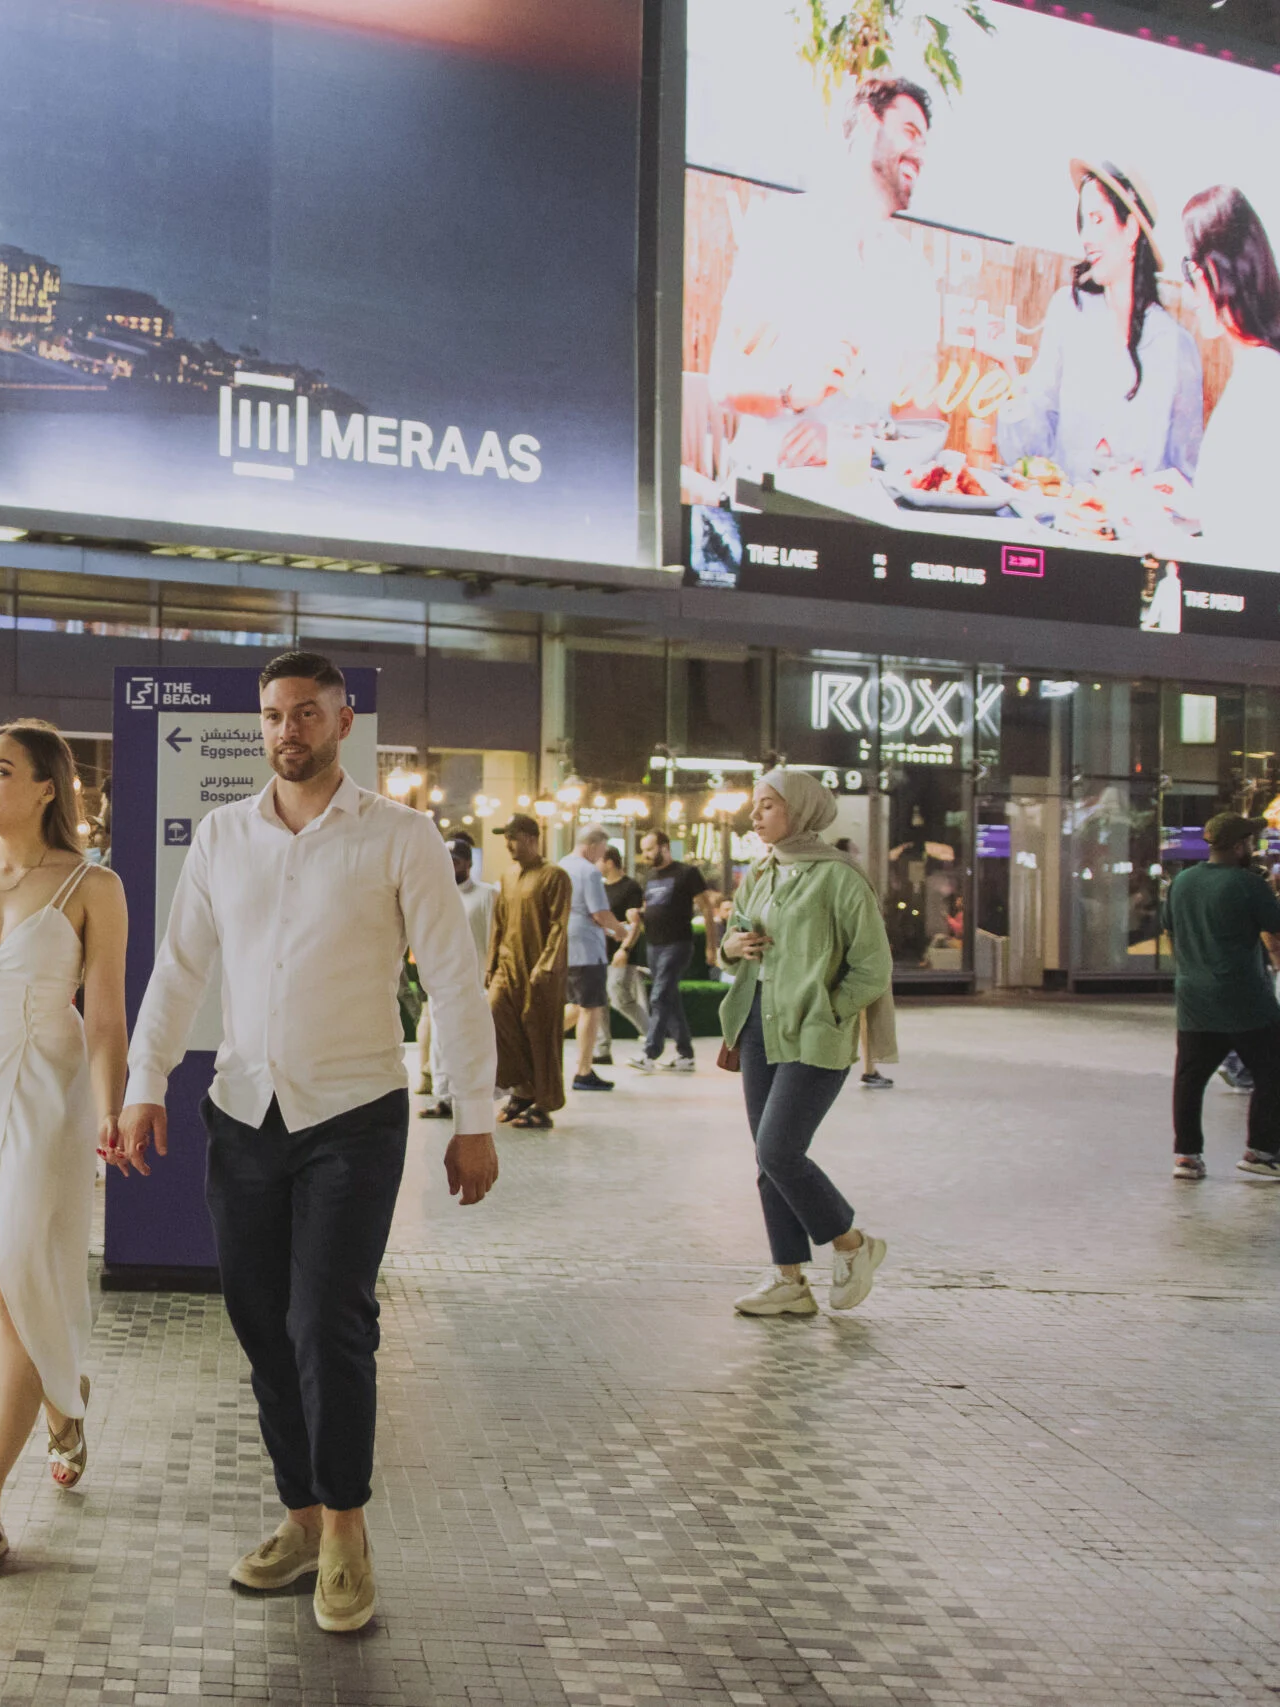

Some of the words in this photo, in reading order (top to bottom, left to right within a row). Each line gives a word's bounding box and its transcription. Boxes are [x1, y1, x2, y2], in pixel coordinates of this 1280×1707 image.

[321, 409, 542, 483] MERAAS
[163, 682, 192, 694] THE
[162, 693, 211, 705] BEACH
[200, 790, 257, 804] Bospor
